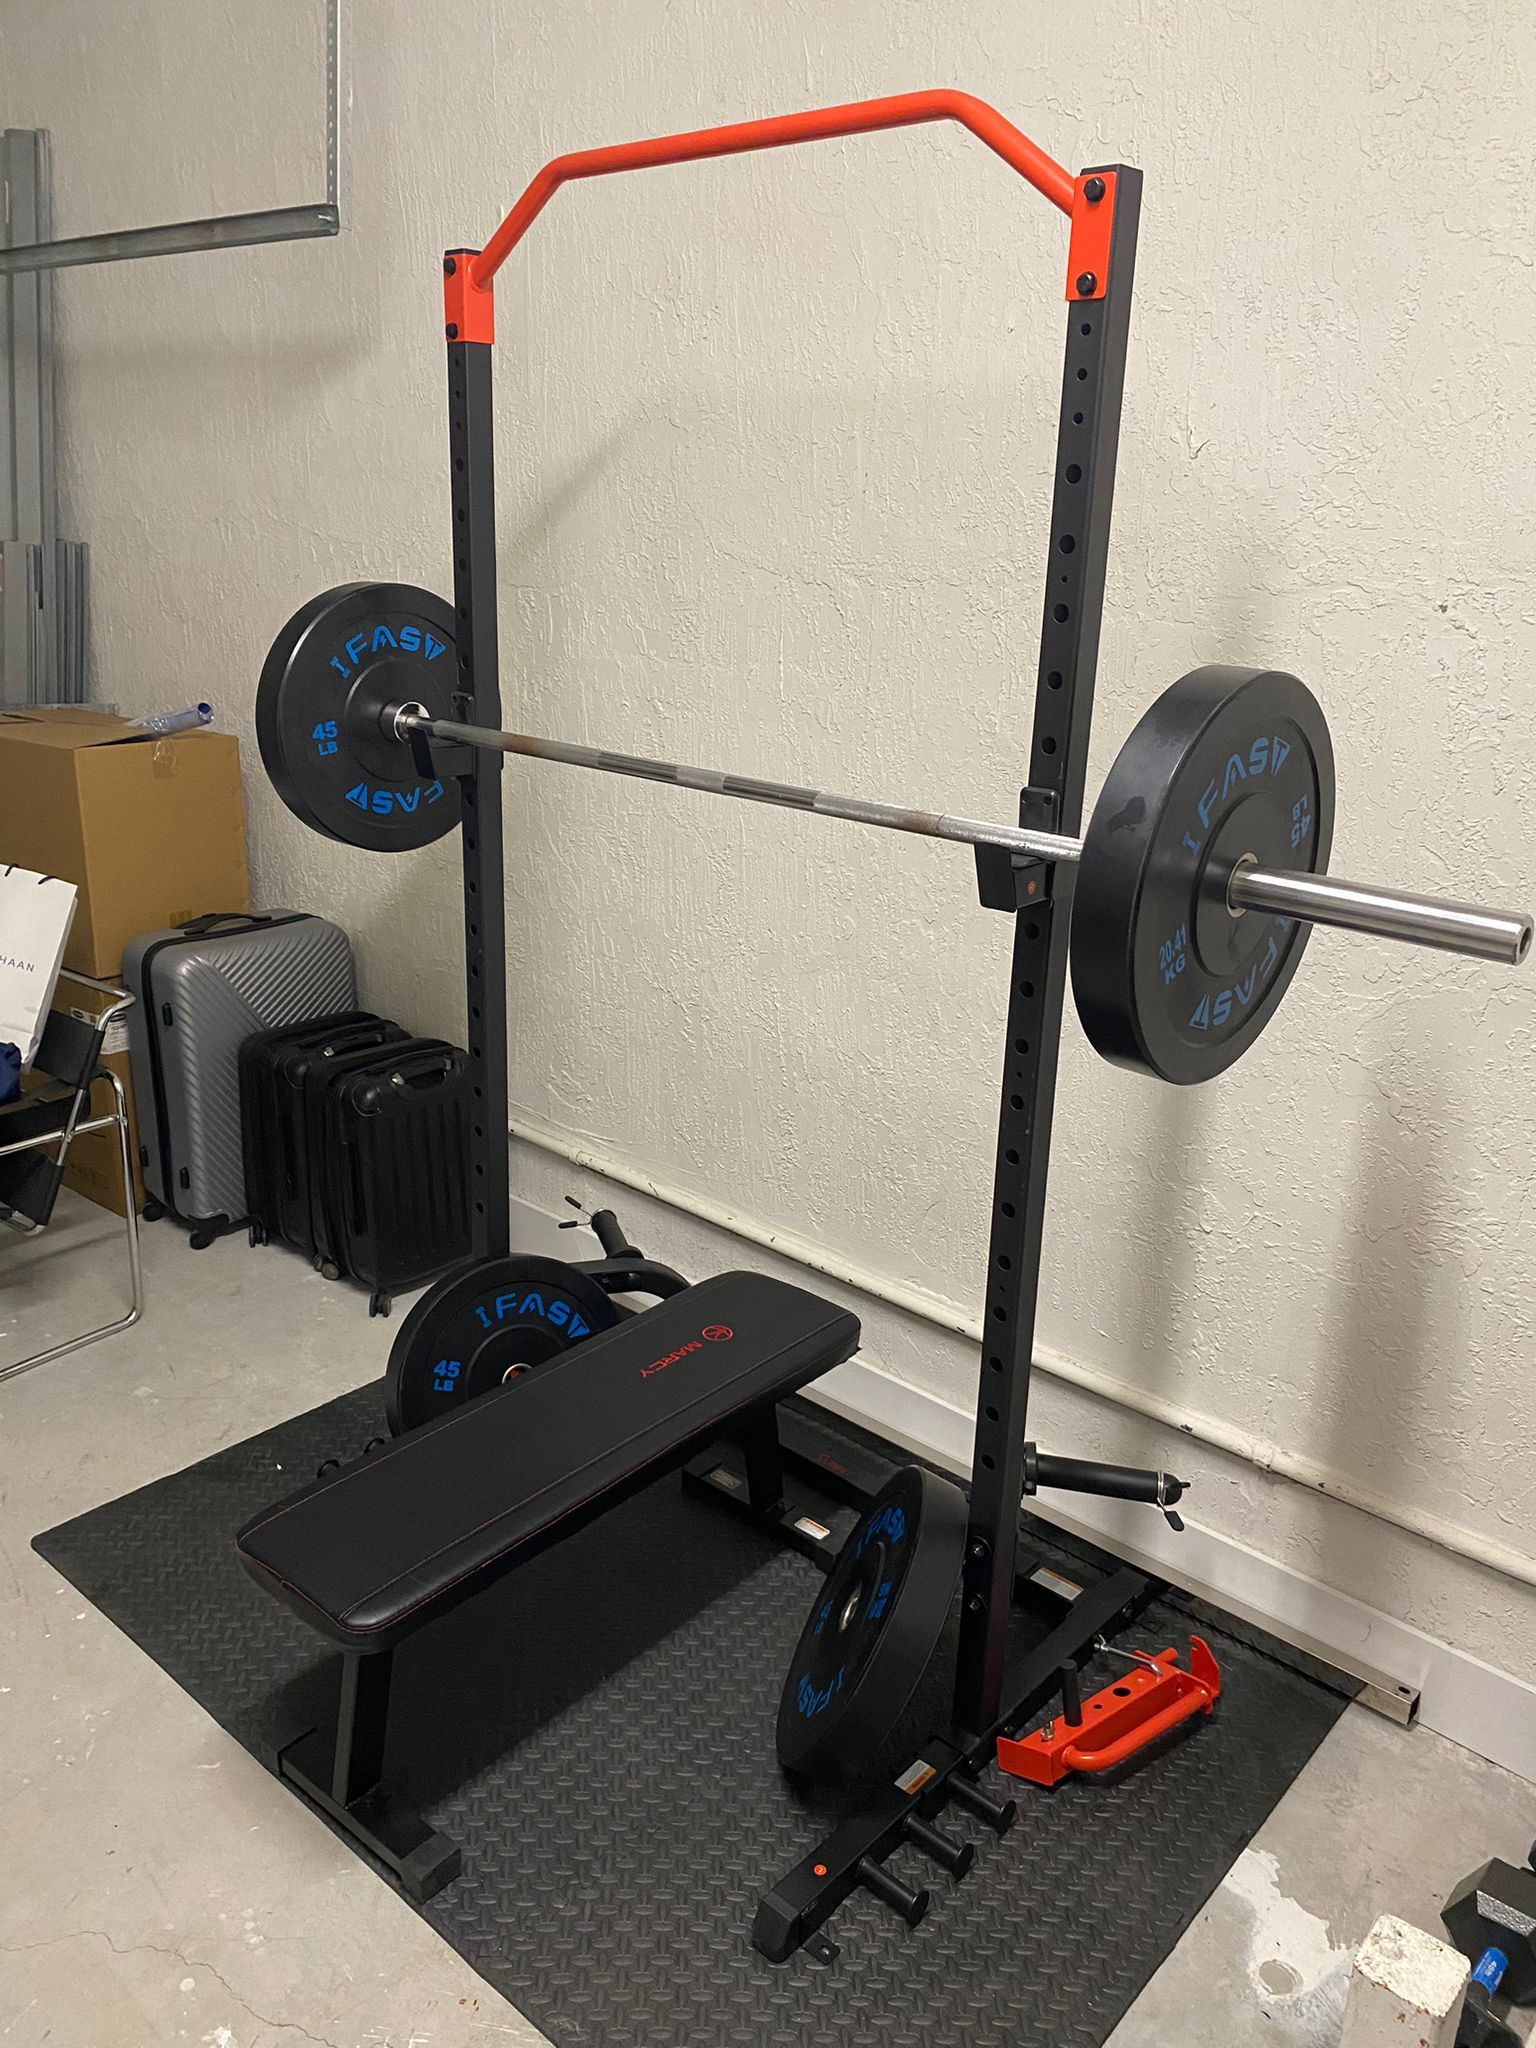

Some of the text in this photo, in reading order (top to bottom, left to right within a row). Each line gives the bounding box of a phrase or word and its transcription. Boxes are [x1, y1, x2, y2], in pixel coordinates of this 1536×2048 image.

[311, 720, 338, 741] 45
[317, 740, 338, 756] LB
[345, 776, 447, 815] FAST
[1291, 814, 1310, 849] 45
[1159, 923, 1187, 970] 20.41
[1164, 953, 1185, 985] KG
[433, 1360, 461, 1378] 45
[640, 1340, 702, 1378] MARCY
[432, 1378, 455, 1392] LB
